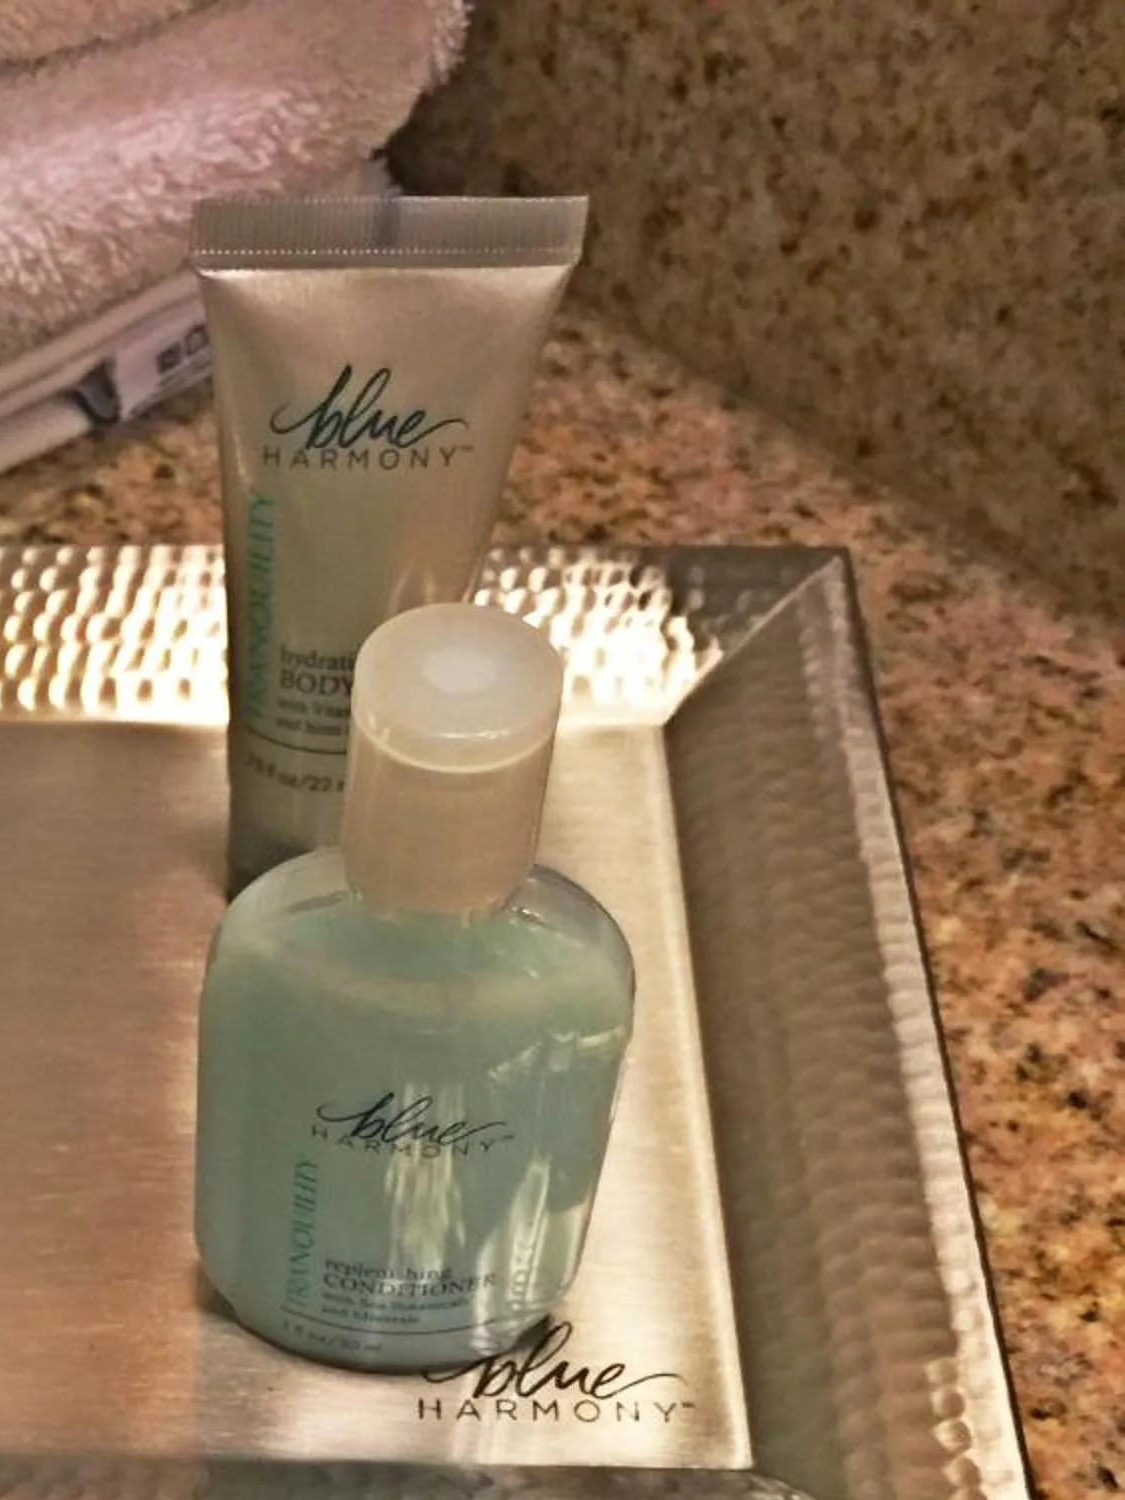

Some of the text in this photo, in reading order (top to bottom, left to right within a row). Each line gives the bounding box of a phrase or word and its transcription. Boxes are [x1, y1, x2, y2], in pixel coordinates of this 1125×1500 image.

[269, 362, 470, 450] blue
[262, 444, 458, 471] HARMONY
[280, 644, 355, 672] hydrati
[316, 1091, 509, 1146] blue
[310, 1124, 499, 1159] HARMONY
[325, 1257, 453, 1282] replenihing
[323, 1271, 497, 1298] CONDITIONER
[420, 1312, 686, 1400] blue
[417, 1396, 677, 1424] HARMONY
